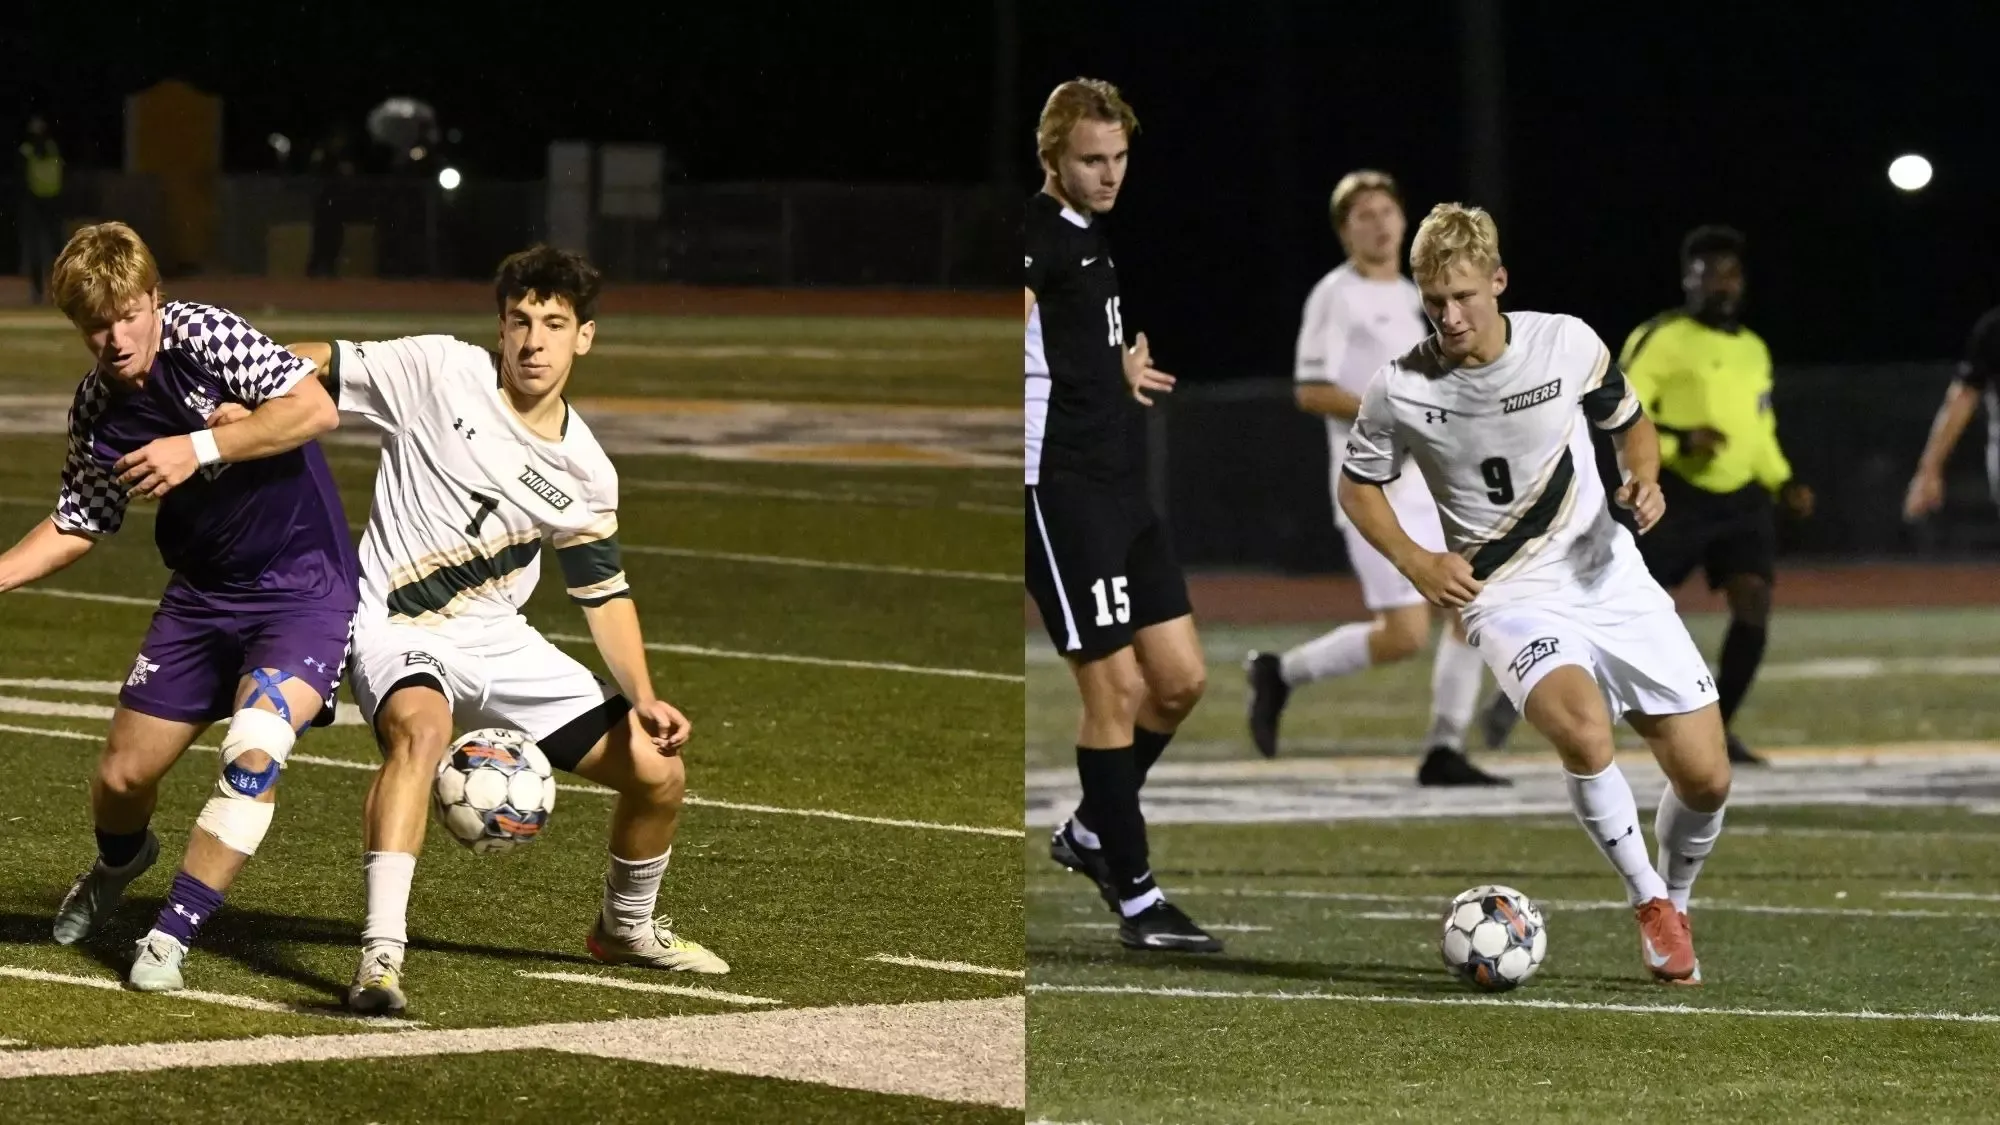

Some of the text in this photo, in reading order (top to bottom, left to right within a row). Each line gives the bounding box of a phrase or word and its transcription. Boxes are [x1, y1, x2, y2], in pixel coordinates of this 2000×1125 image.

[1105, 296, 1123, 347] 15
[1503, 379, 1561, 413] MINERS
[519, 469, 571, 509] MINERS
[1480, 457, 1514, 506] 9
[465, 490, 500, 538] 7
[1091, 576, 1131, 626] 15
